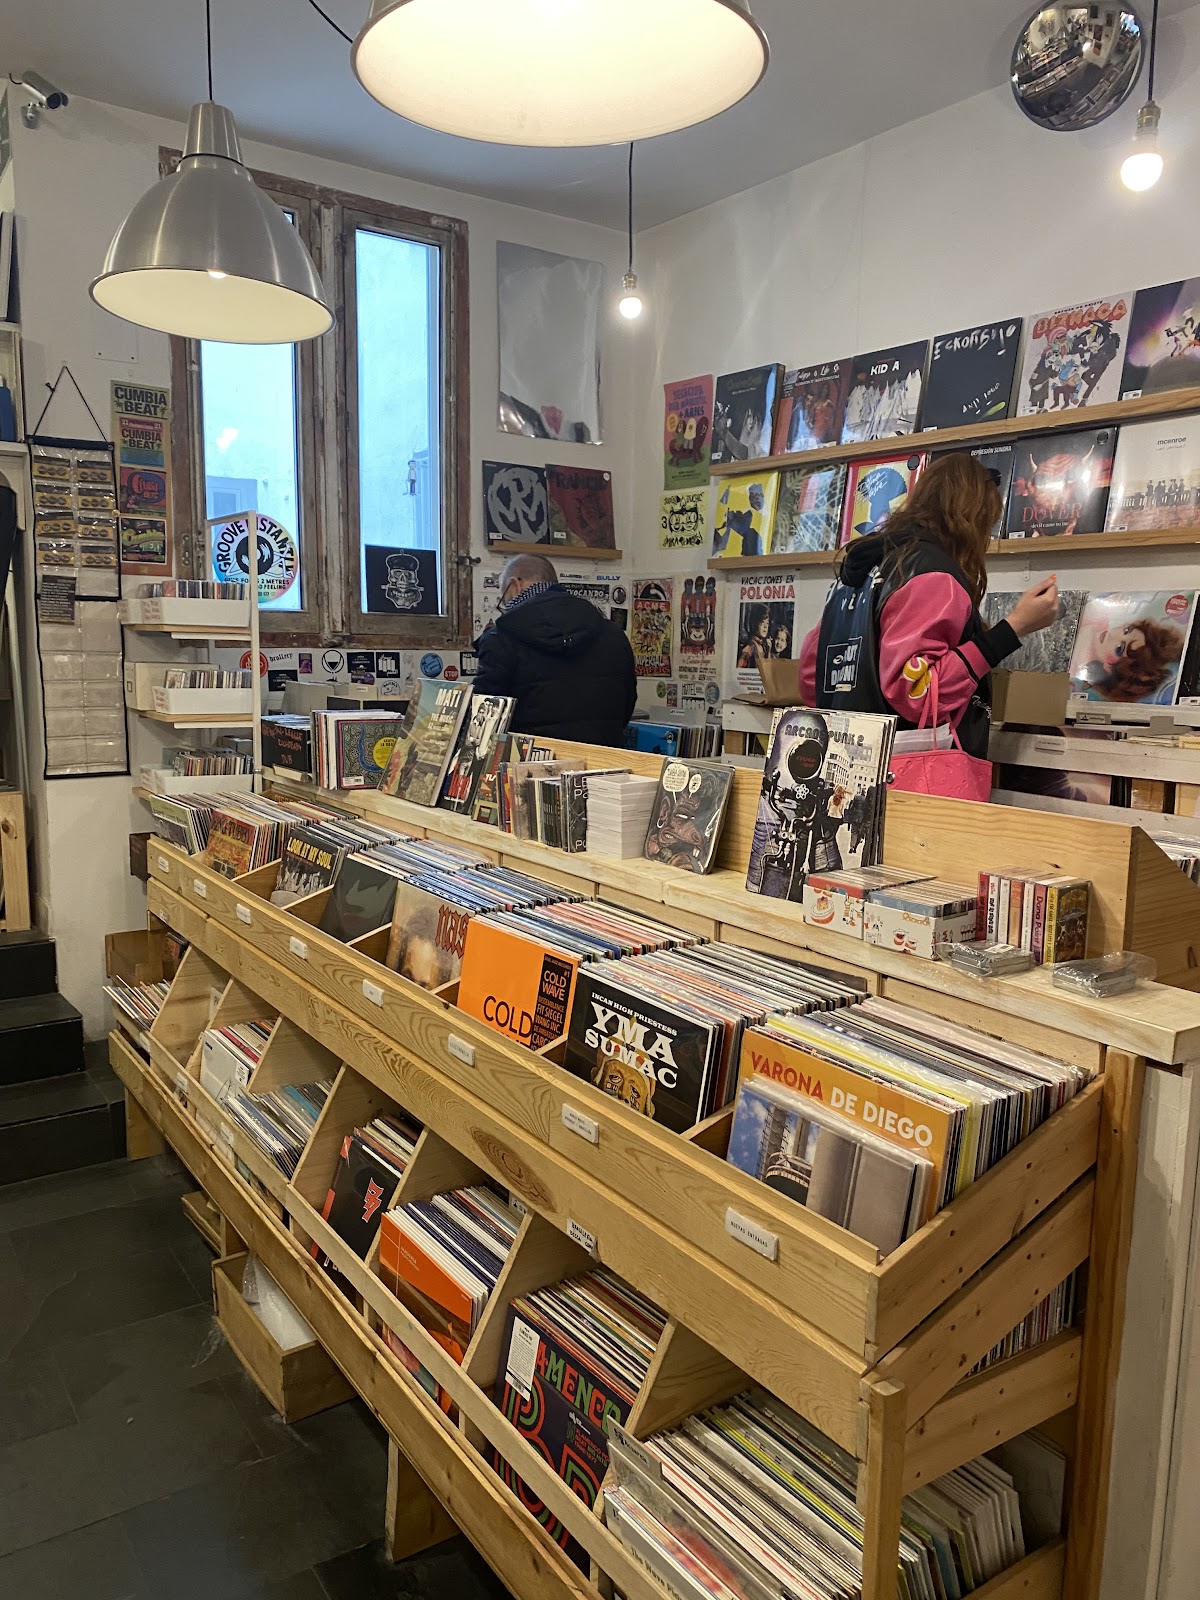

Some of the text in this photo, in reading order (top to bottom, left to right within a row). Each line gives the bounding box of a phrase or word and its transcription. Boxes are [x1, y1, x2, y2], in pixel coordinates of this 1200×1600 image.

[870, 363, 889, 376] KID
[891, 360, 900, 372] A
[114, 386, 168, 406] CUMBIA
[124, 400, 160, 416] BEAT
[121, 428, 162, 442] CUMBIA
[128, 438, 156, 450] BEAT
[1157, 436, 1187, 446] mcenroe
[1021, 502, 1083, 523] DOVER
[216, 520, 246, 573] GROOVE
[741, 574, 796, 586] VACACIONES EN
[740, 584, 796, 600] POLONIA
[637, 601, 667, 610] ACME
[444, 670, 459, 678] STOP
[784, 724, 823, 740] ARCAD
[828, 730, 856, 745] PUNK
[286, 836, 333, 870] LOOK AT MY SOUL
[1034, 895, 1044, 944] Dana Point
[543, 969, 567, 989] COLD
[542, 980, 566, 1001] WAVE
[483, 995, 533, 1038] COLD
[592, 991, 678, 1037] INCAN HIGH PRIESTESS
[590, 1001, 679, 1069] YMA
[584, 1028, 678, 1089] SUMAC
[751, 1051, 933, 1147] VARONA DE DIEGO
[730, 1220, 768, 1248] NUEVAS ENTRADAS
